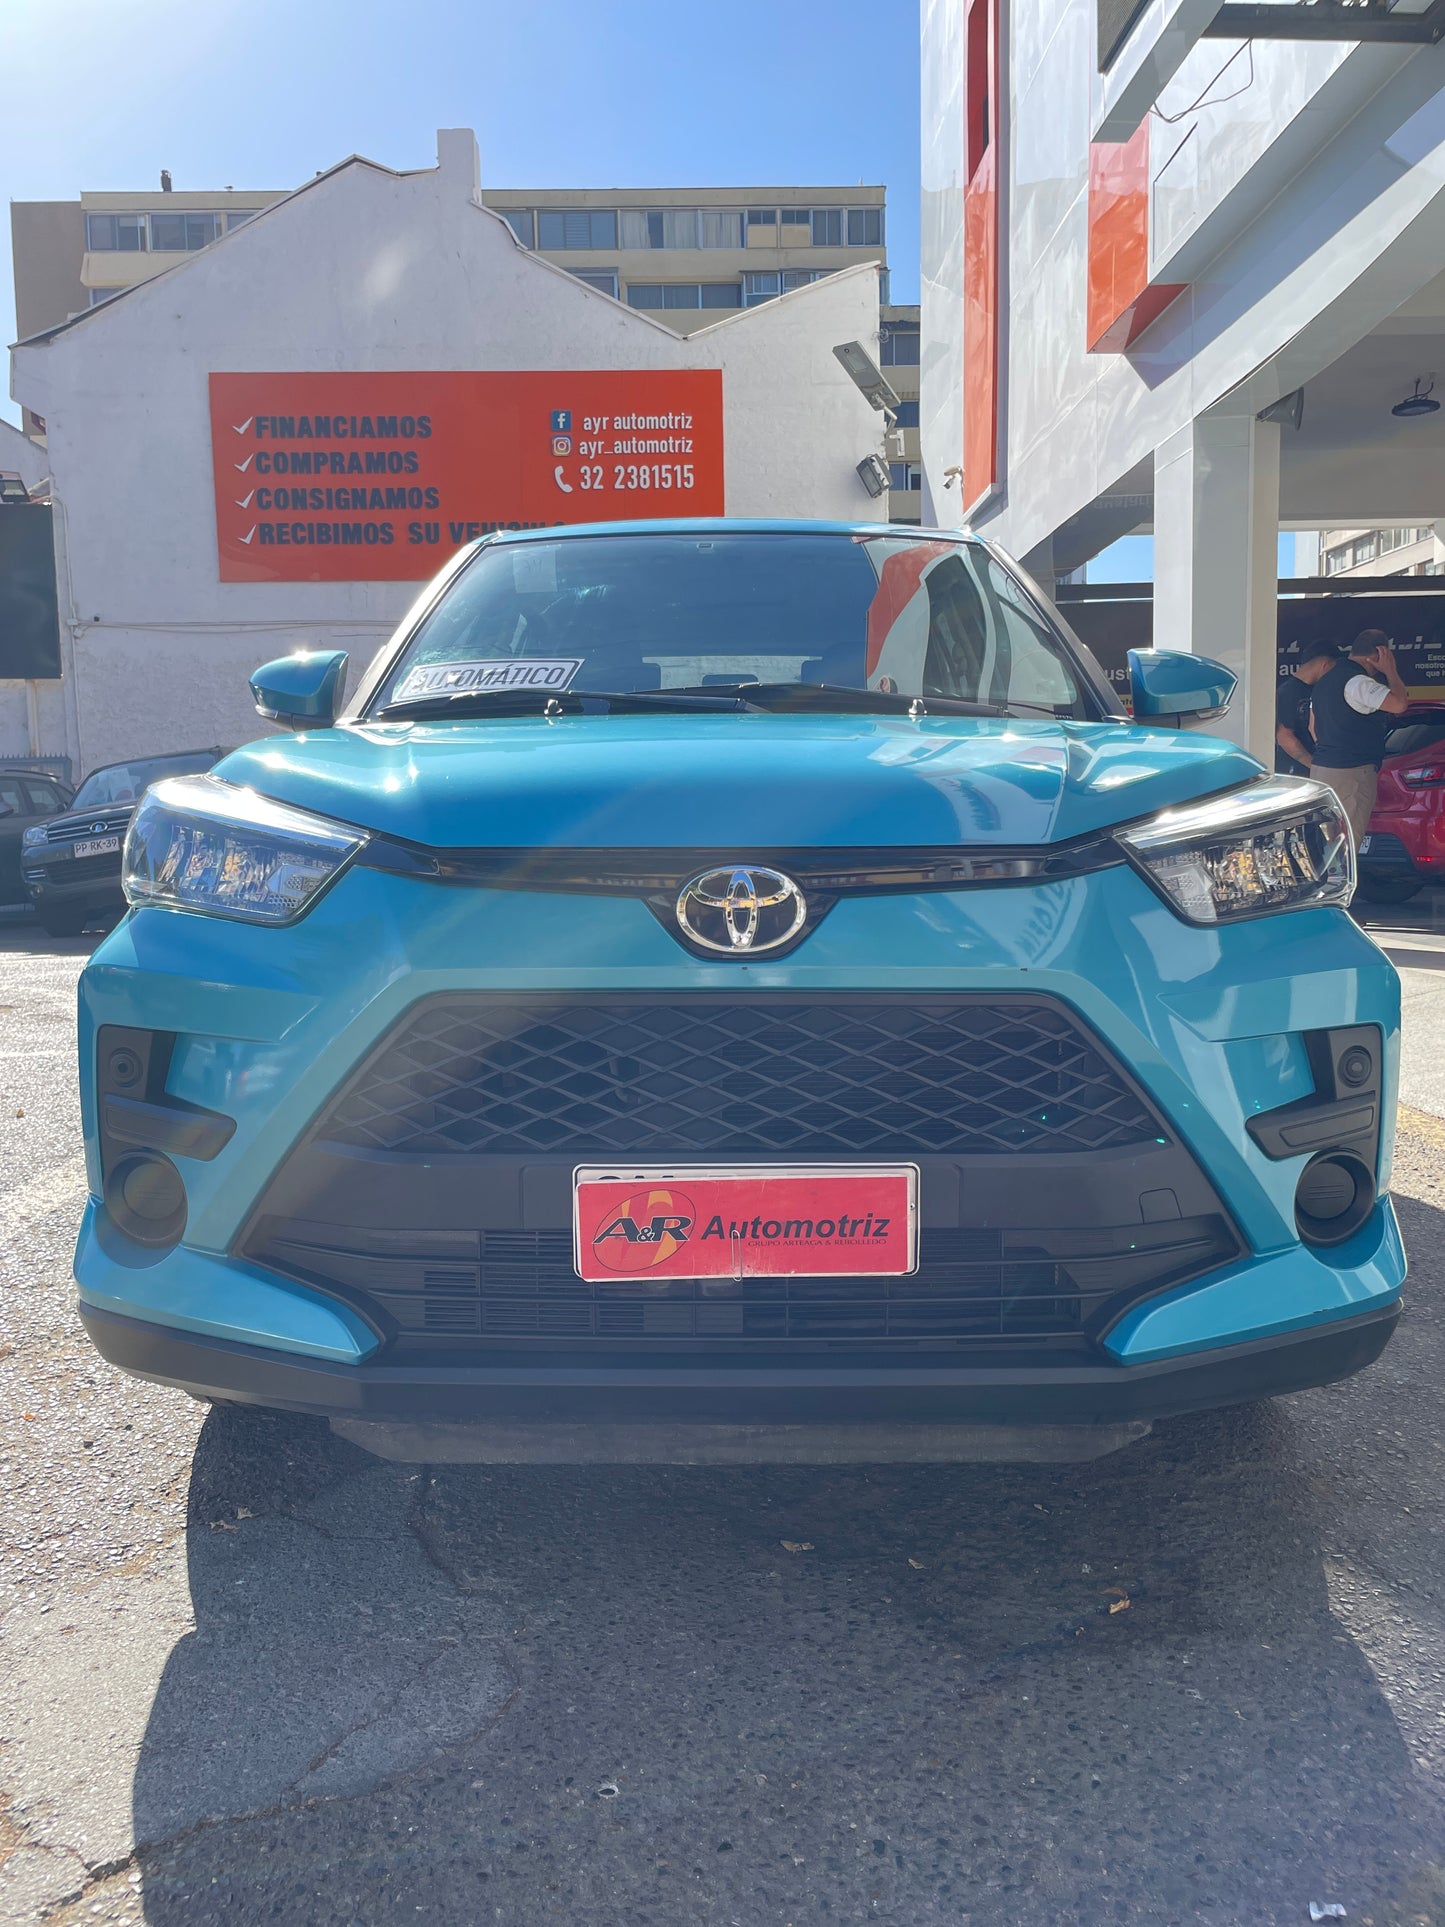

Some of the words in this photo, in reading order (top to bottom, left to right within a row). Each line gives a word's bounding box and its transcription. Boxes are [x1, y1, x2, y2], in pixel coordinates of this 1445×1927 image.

[255, 415, 433, 439] FINANCIAMOS
[583, 416, 610, 435] ayr
[613, 412, 694, 430] automotriz
[579, 435, 694, 460] ayr_automotriz
[255, 451, 420, 475] COMPRAMOS
[580, 465, 605, 490] 32
[613, 464, 695, 490] 2381515
[256, 486, 440, 511] CONSIGNAMOS
[259, 521, 395, 546] RECIBIMOS
[408, 521, 441, 545] SU
[592, 1215, 693, 1245] A&R
[700, 1212, 892, 1241] Automotriz
[748, 1240, 781, 1248] GRUPO
[783, 1239, 823, 1247] ARTEAGA
[834, 1238, 887, 1247] REBOLLEDO
